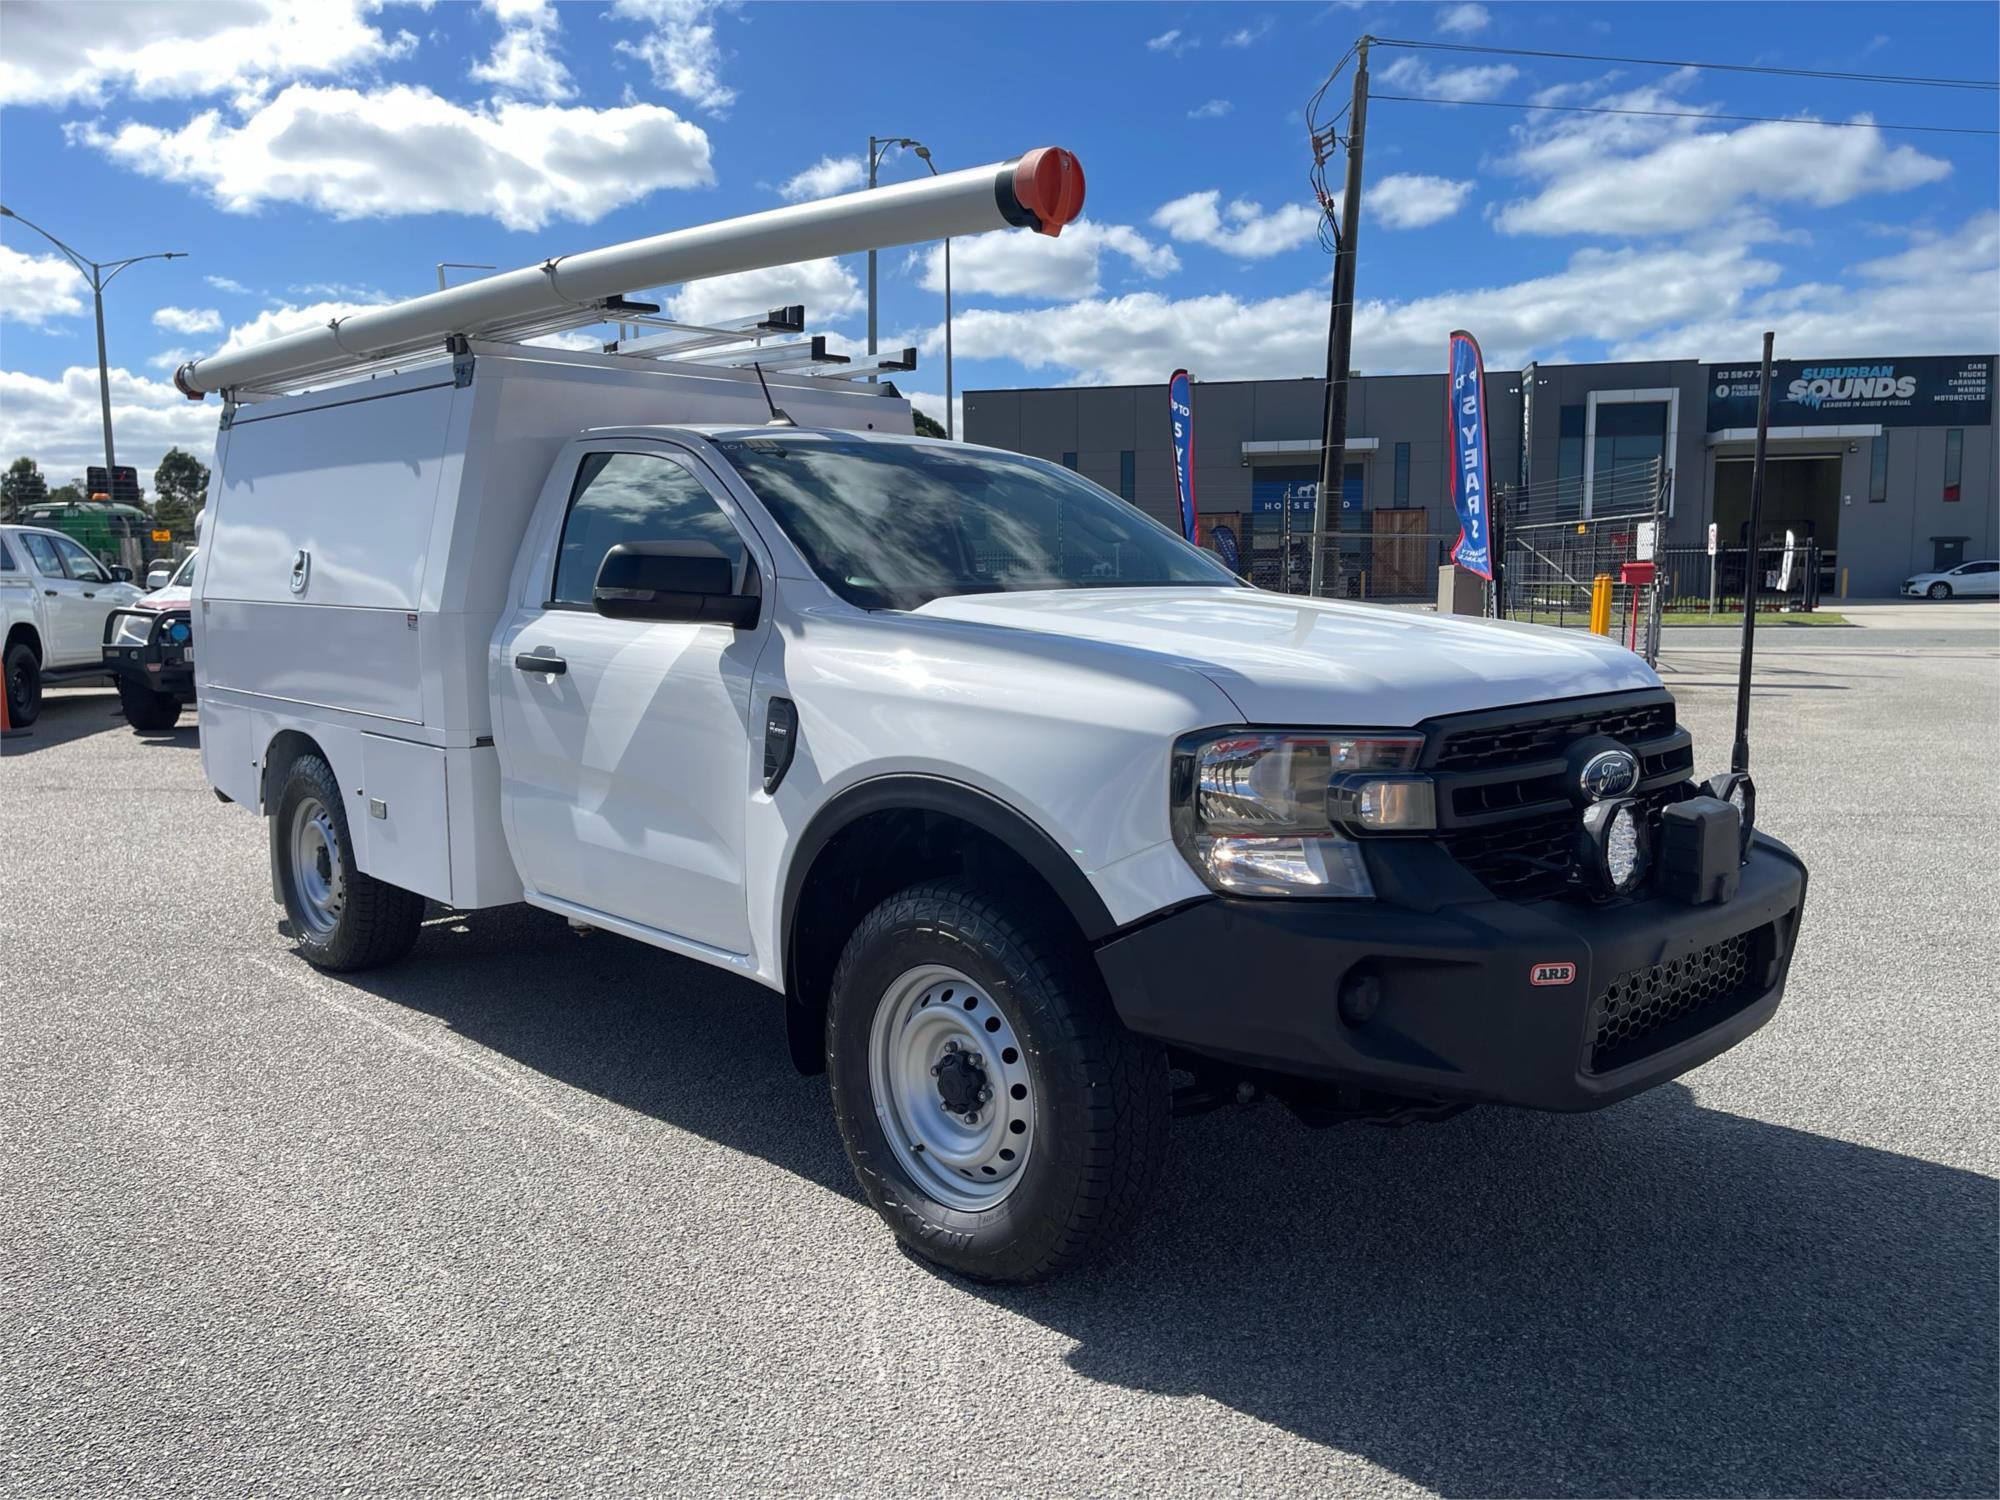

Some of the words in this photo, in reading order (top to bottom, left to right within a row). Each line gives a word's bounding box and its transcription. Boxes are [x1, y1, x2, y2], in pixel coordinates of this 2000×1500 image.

[1801, 365, 1895, 379] SUBURBAN
[1786, 375, 1917, 401] SOUNDS
[1179, 404, 1190, 416] TO
[1174, 422, 1183, 438] 5
[1264, 502, 1351, 510] HOSED
[1600, 761, 1632, 792] Ford
[1537, 967, 1570, 980] ARB
